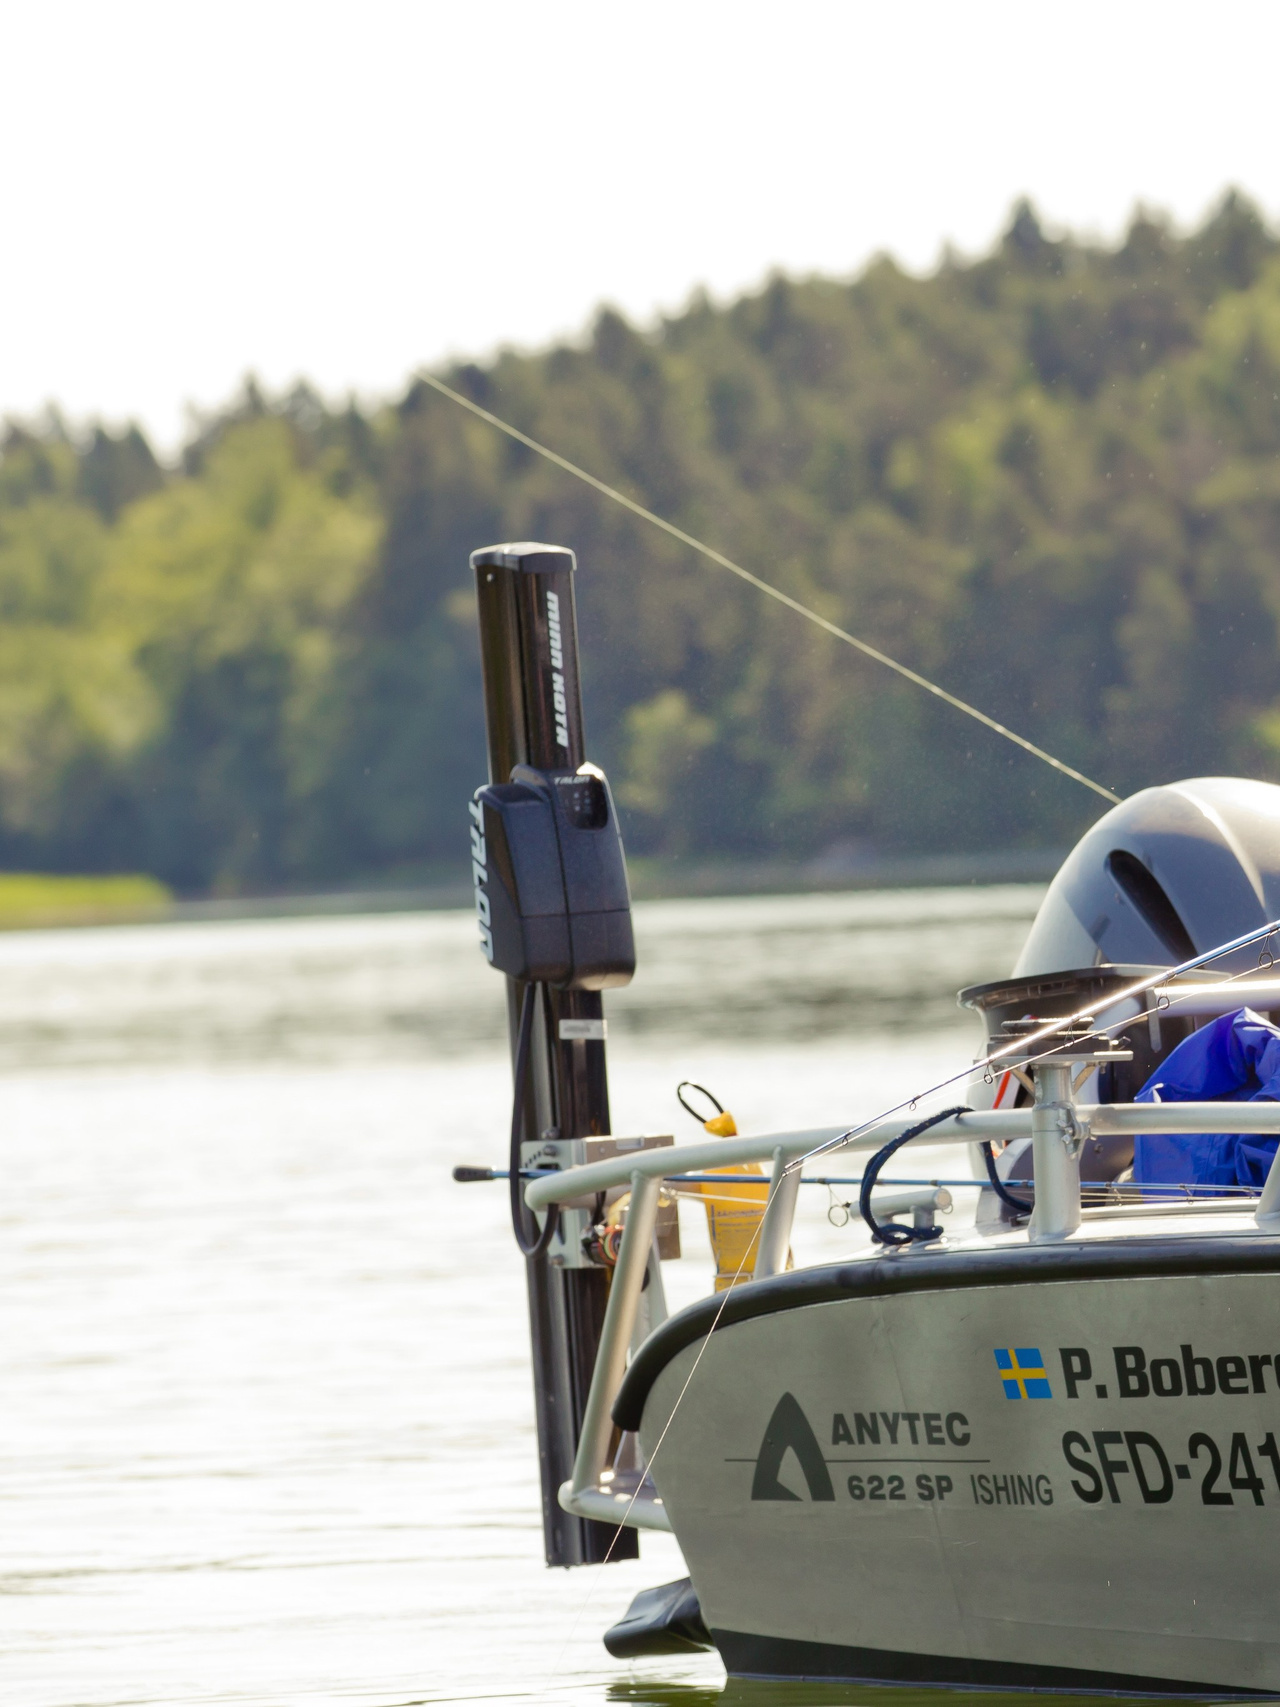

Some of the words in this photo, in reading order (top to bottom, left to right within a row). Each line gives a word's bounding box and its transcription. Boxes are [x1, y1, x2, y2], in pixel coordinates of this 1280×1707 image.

[552, 672, 569, 748] KOTA
[468, 799, 494, 962] TALON
[831, 1411, 971, 1446] ANYTEC
[847, 1474, 907, 1501] 622
[915, 1473, 954, 1502] SP
[970, 1474, 1054, 1506] ISHING
